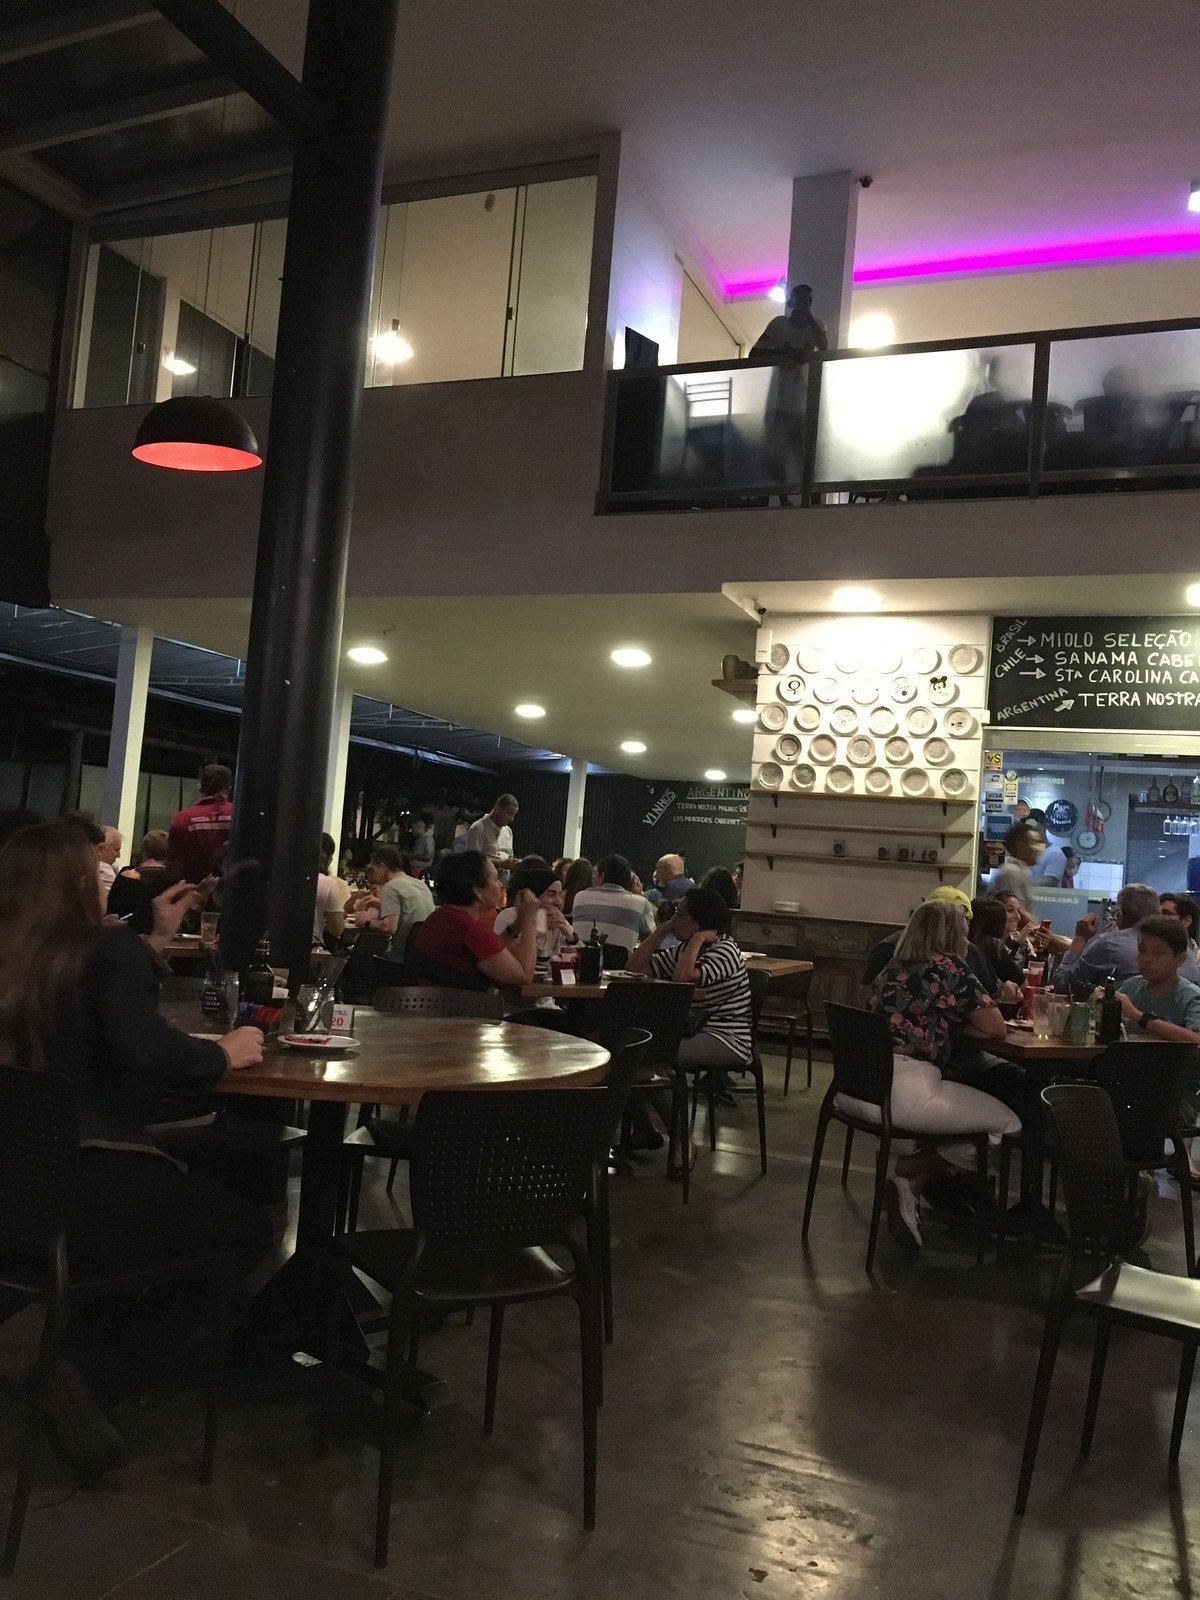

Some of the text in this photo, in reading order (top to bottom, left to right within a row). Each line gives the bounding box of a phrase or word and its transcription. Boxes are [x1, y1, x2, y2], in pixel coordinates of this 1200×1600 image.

[993, 618, 1027, 653] BRASIL
[1041, 629, 1191, 650] MIOLO SELEÇÃO
[994, 648, 1027, 678] CHILE
[1055, 651, 1200, 668] SANAMA CABE
[1088, 669, 1173, 685] CAROLINA
[997, 686, 1069, 721] ARGENTINA
[1078, 691, 1141, 707] TERRA
[642, 786, 676, 825] VINHOS
